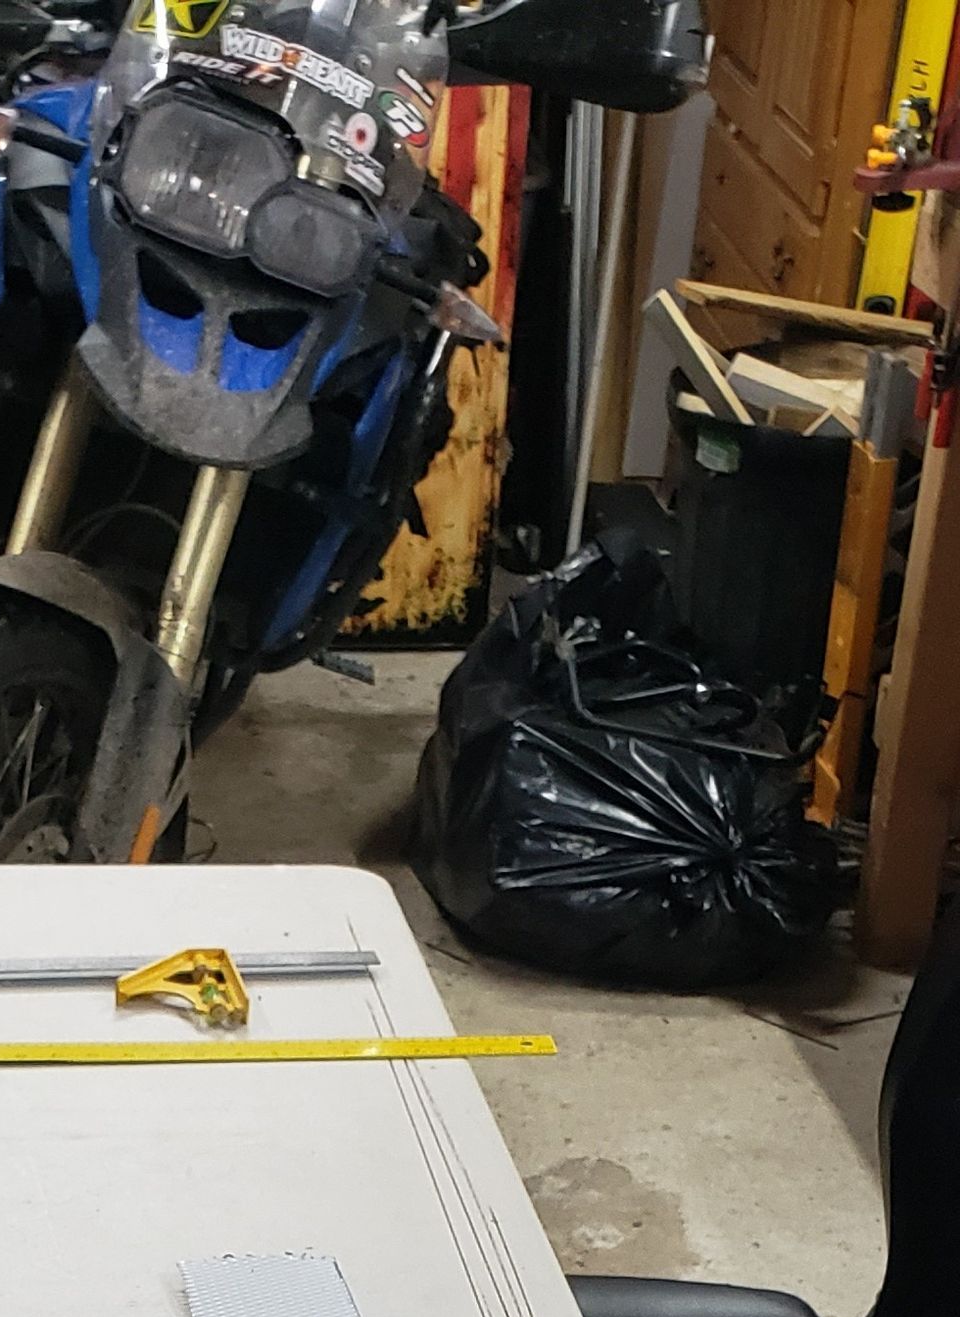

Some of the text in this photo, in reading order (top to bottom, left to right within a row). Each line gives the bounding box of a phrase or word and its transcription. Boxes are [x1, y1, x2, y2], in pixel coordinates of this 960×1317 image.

[172, 51, 247, 76] RIDE
[246, 69, 283, 86] IT
[221, 25, 374, 108] WILD HEART
